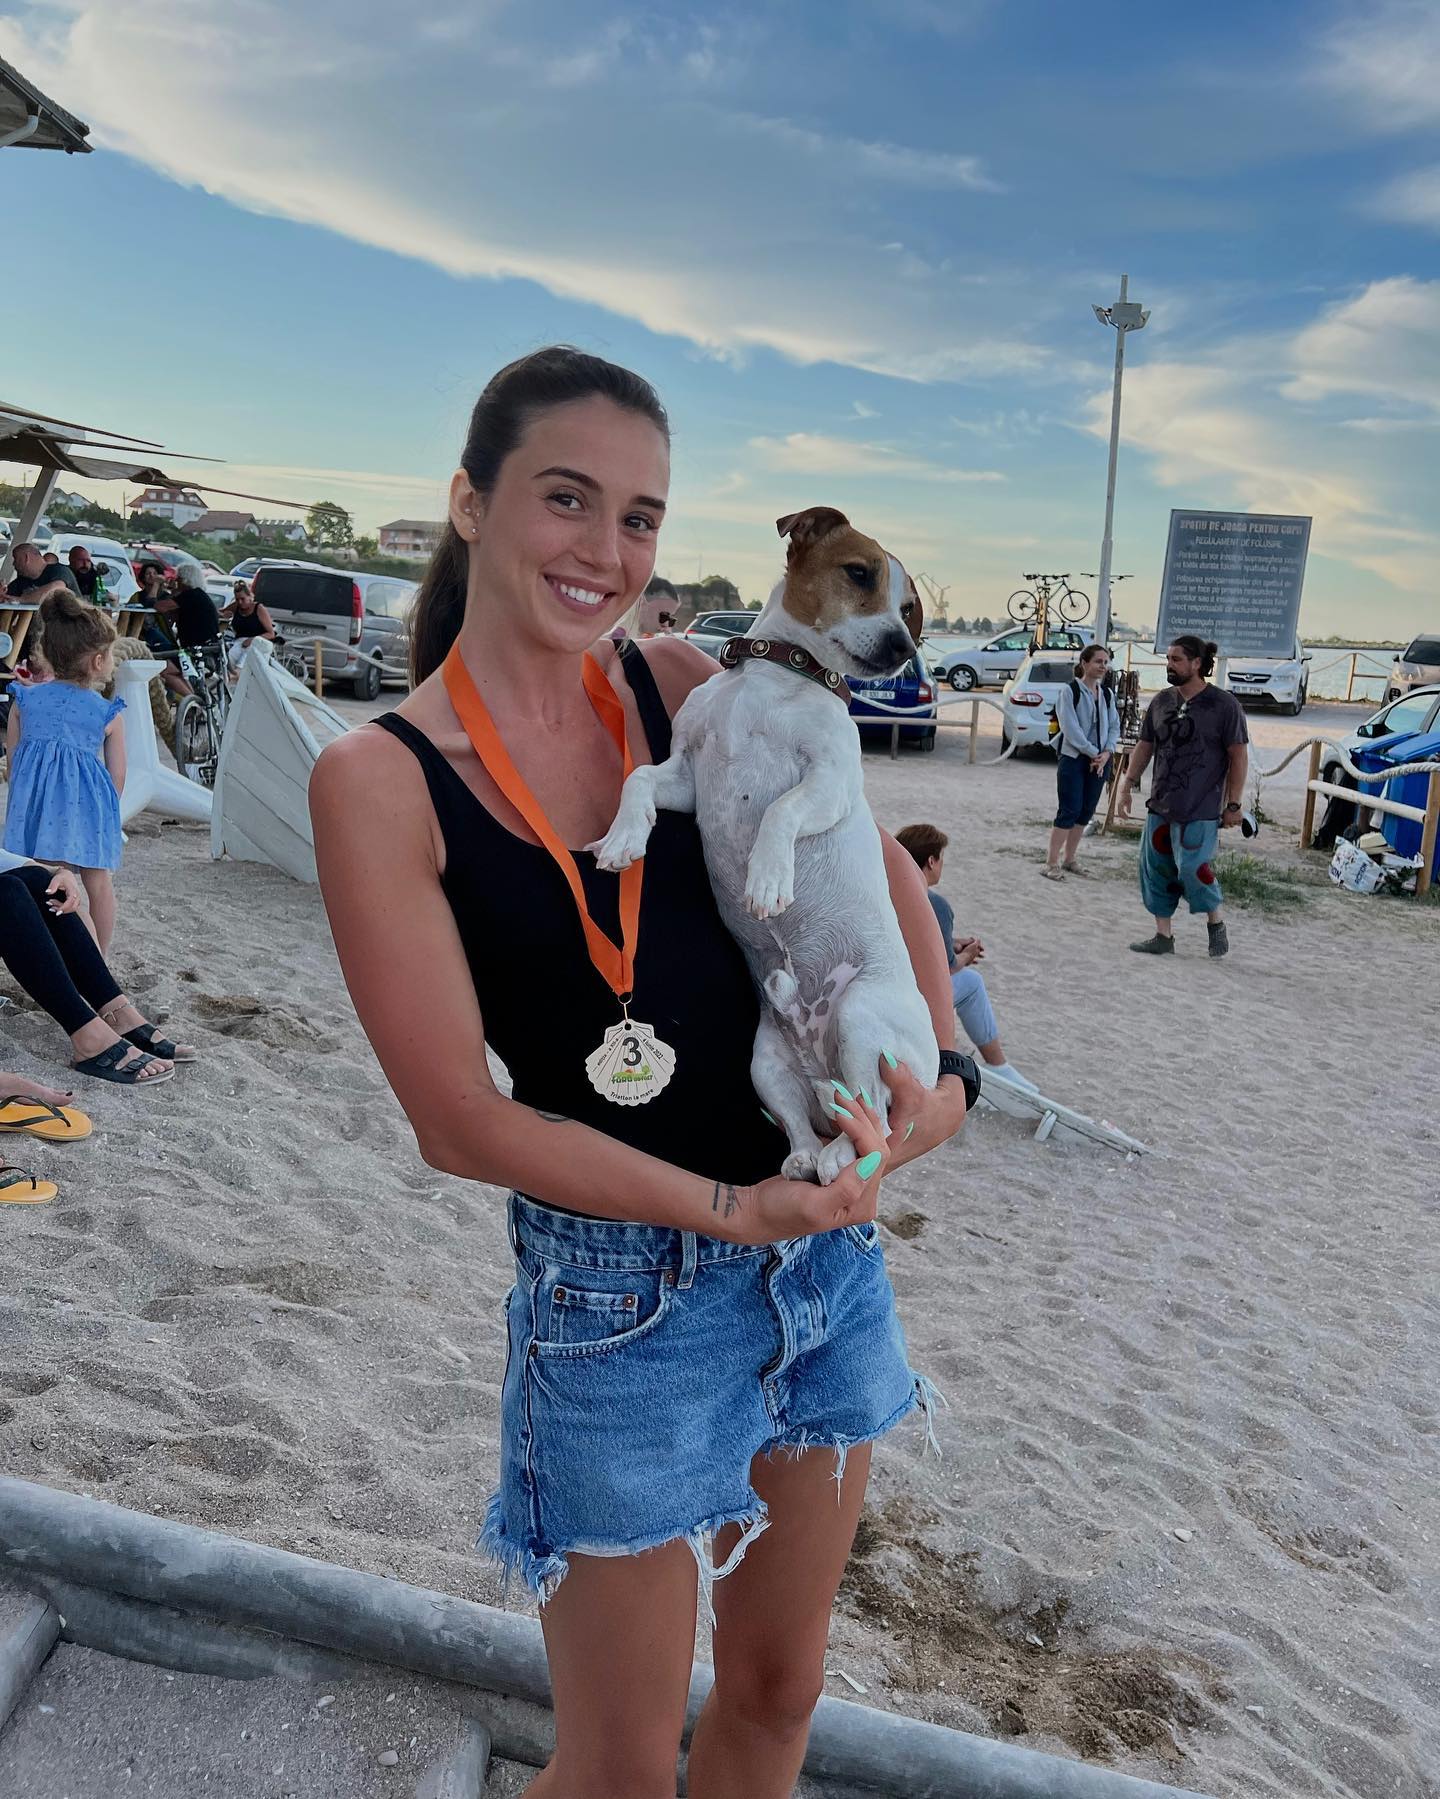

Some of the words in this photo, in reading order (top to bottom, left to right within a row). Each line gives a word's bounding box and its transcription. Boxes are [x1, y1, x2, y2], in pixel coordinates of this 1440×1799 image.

[1249, 523, 1279, 534] PENTRU
[182, 661, 190, 671] 5
[622, 1037, 642, 1066] 3
[610, 1092, 632, 1100] Triatlon
